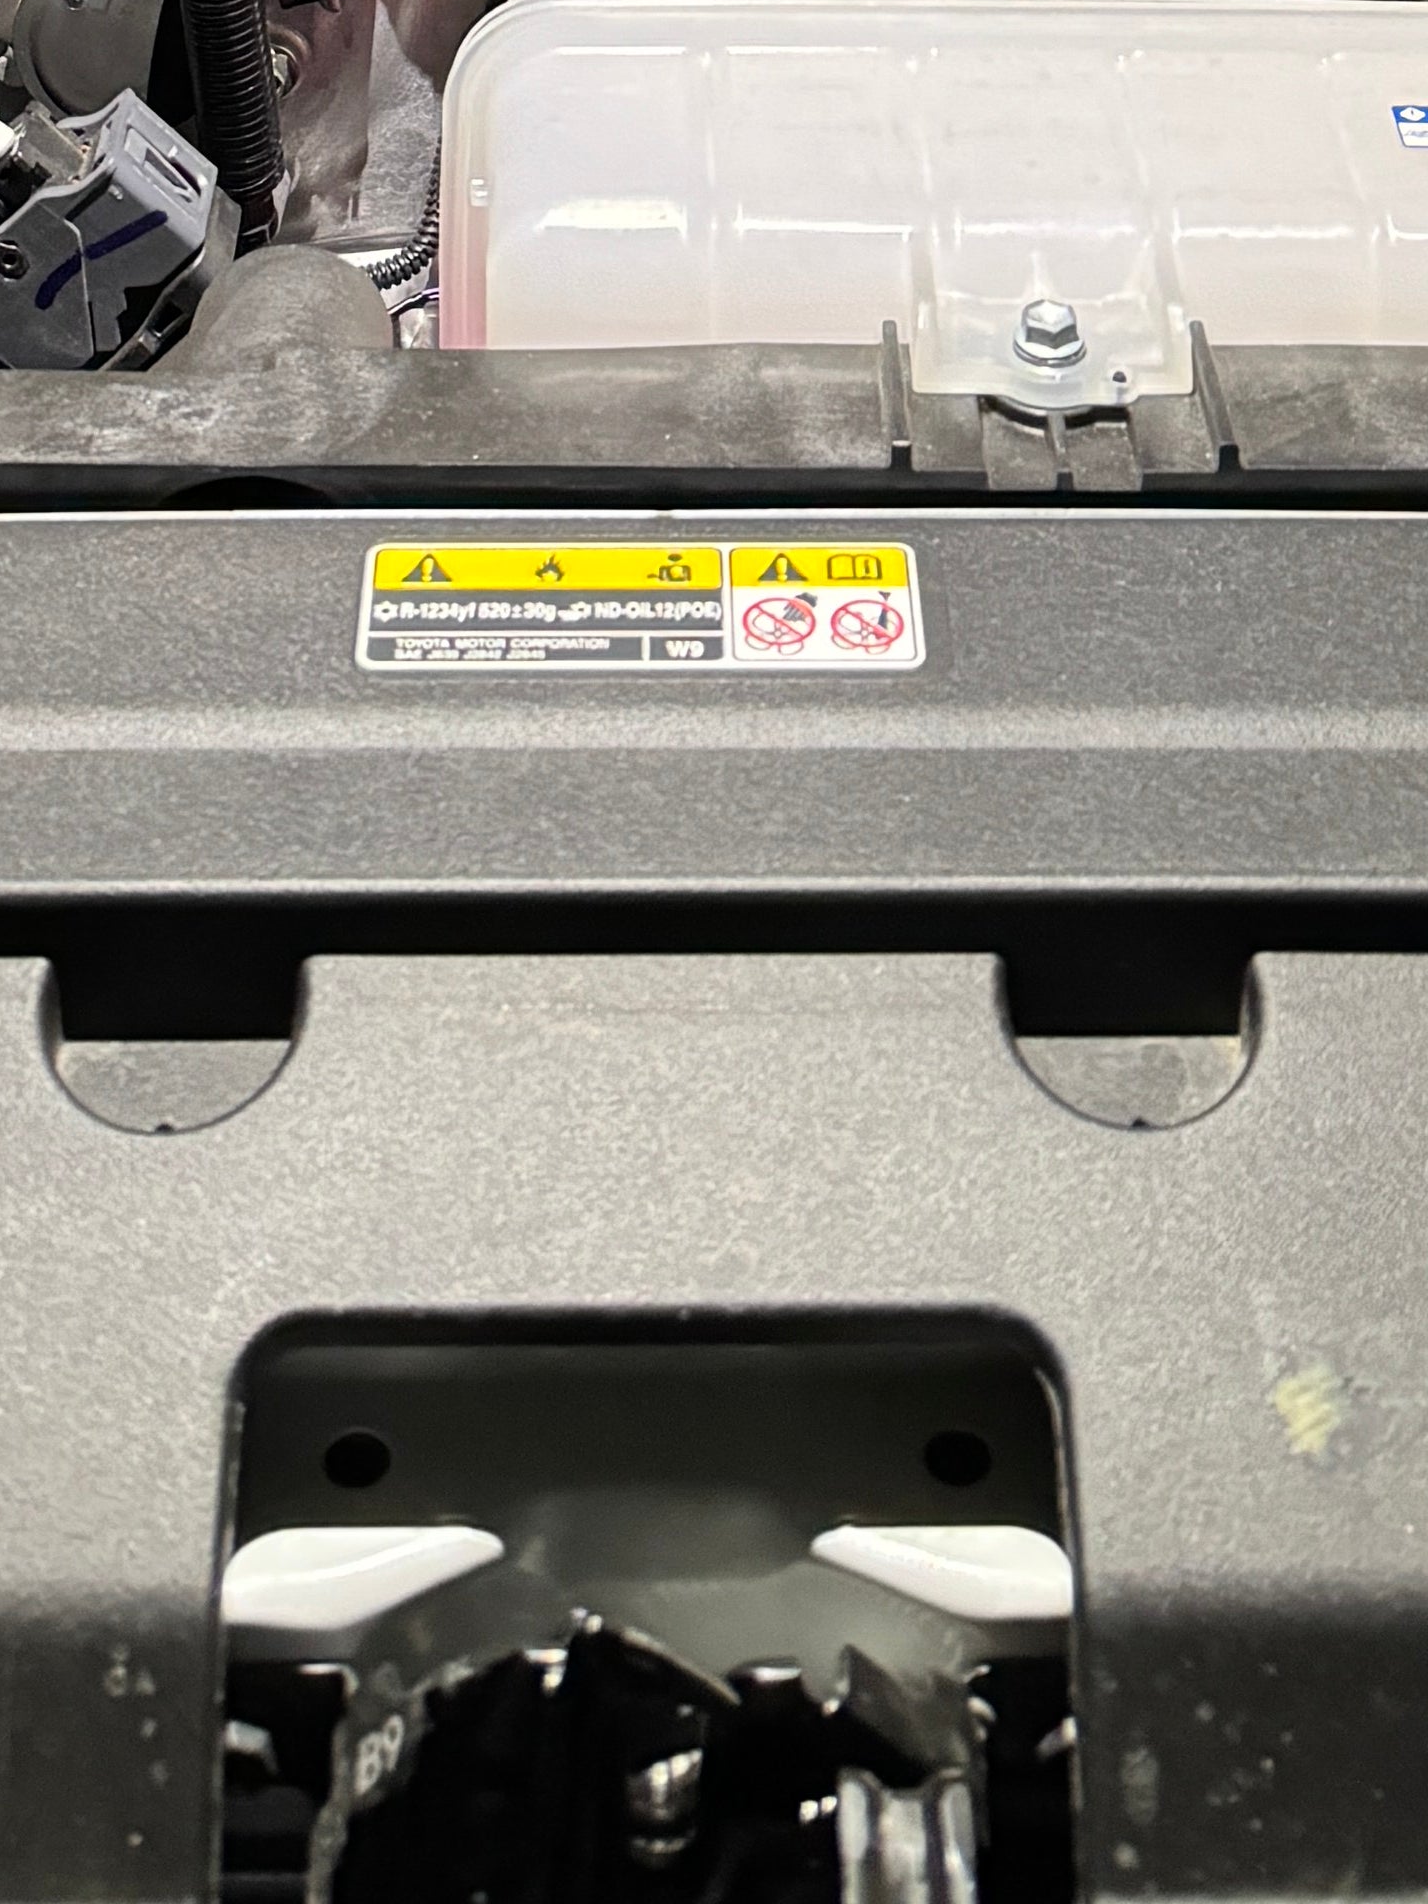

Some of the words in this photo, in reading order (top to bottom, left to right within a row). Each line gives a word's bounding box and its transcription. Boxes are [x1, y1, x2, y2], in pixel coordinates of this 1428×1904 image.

[395, 638, 450, 650] TOYOTA
[455, 638, 507, 650] MOTOR
[510, 638, 610, 650] CORPORATION
[665, 640, 705, 658] W9
